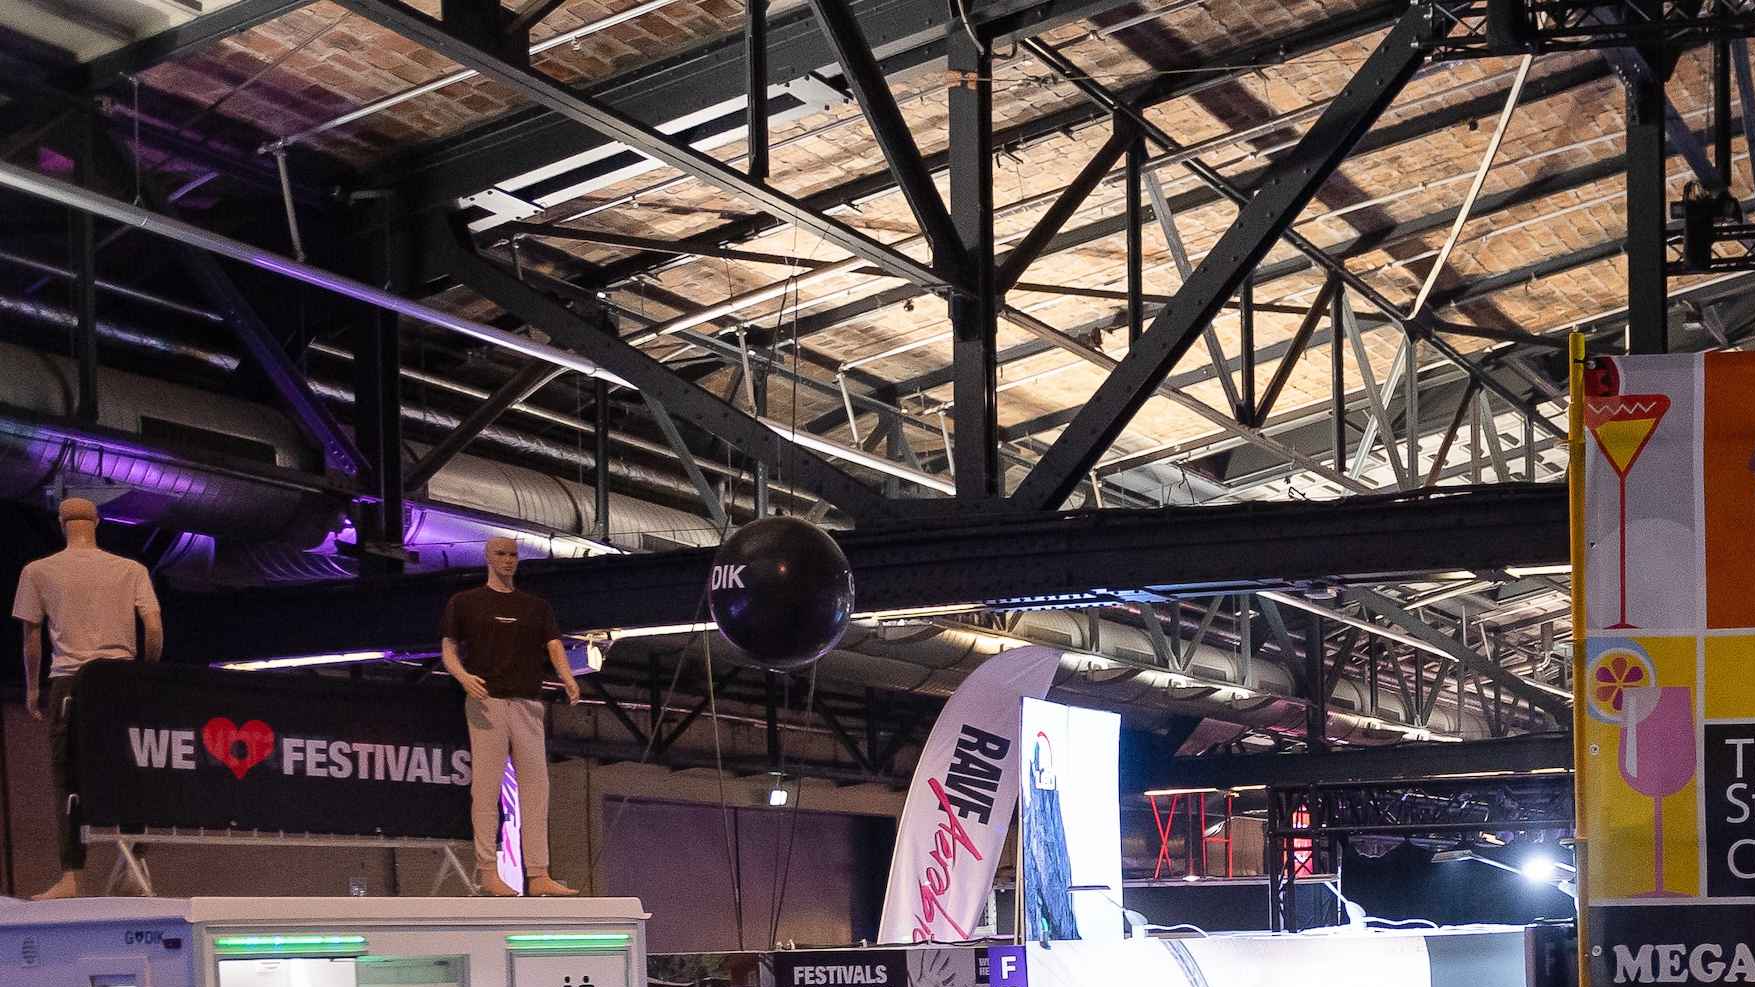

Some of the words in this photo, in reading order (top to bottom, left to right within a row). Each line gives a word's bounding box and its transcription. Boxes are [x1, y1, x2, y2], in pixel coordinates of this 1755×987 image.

[128, 727, 197, 770] WE
[282, 737, 473, 786] FESTIVALS
[938, 723, 1012, 826] RAVE
[794, 965, 887, 985] FESTIVALS
[1001, 956, 1017, 979] F
